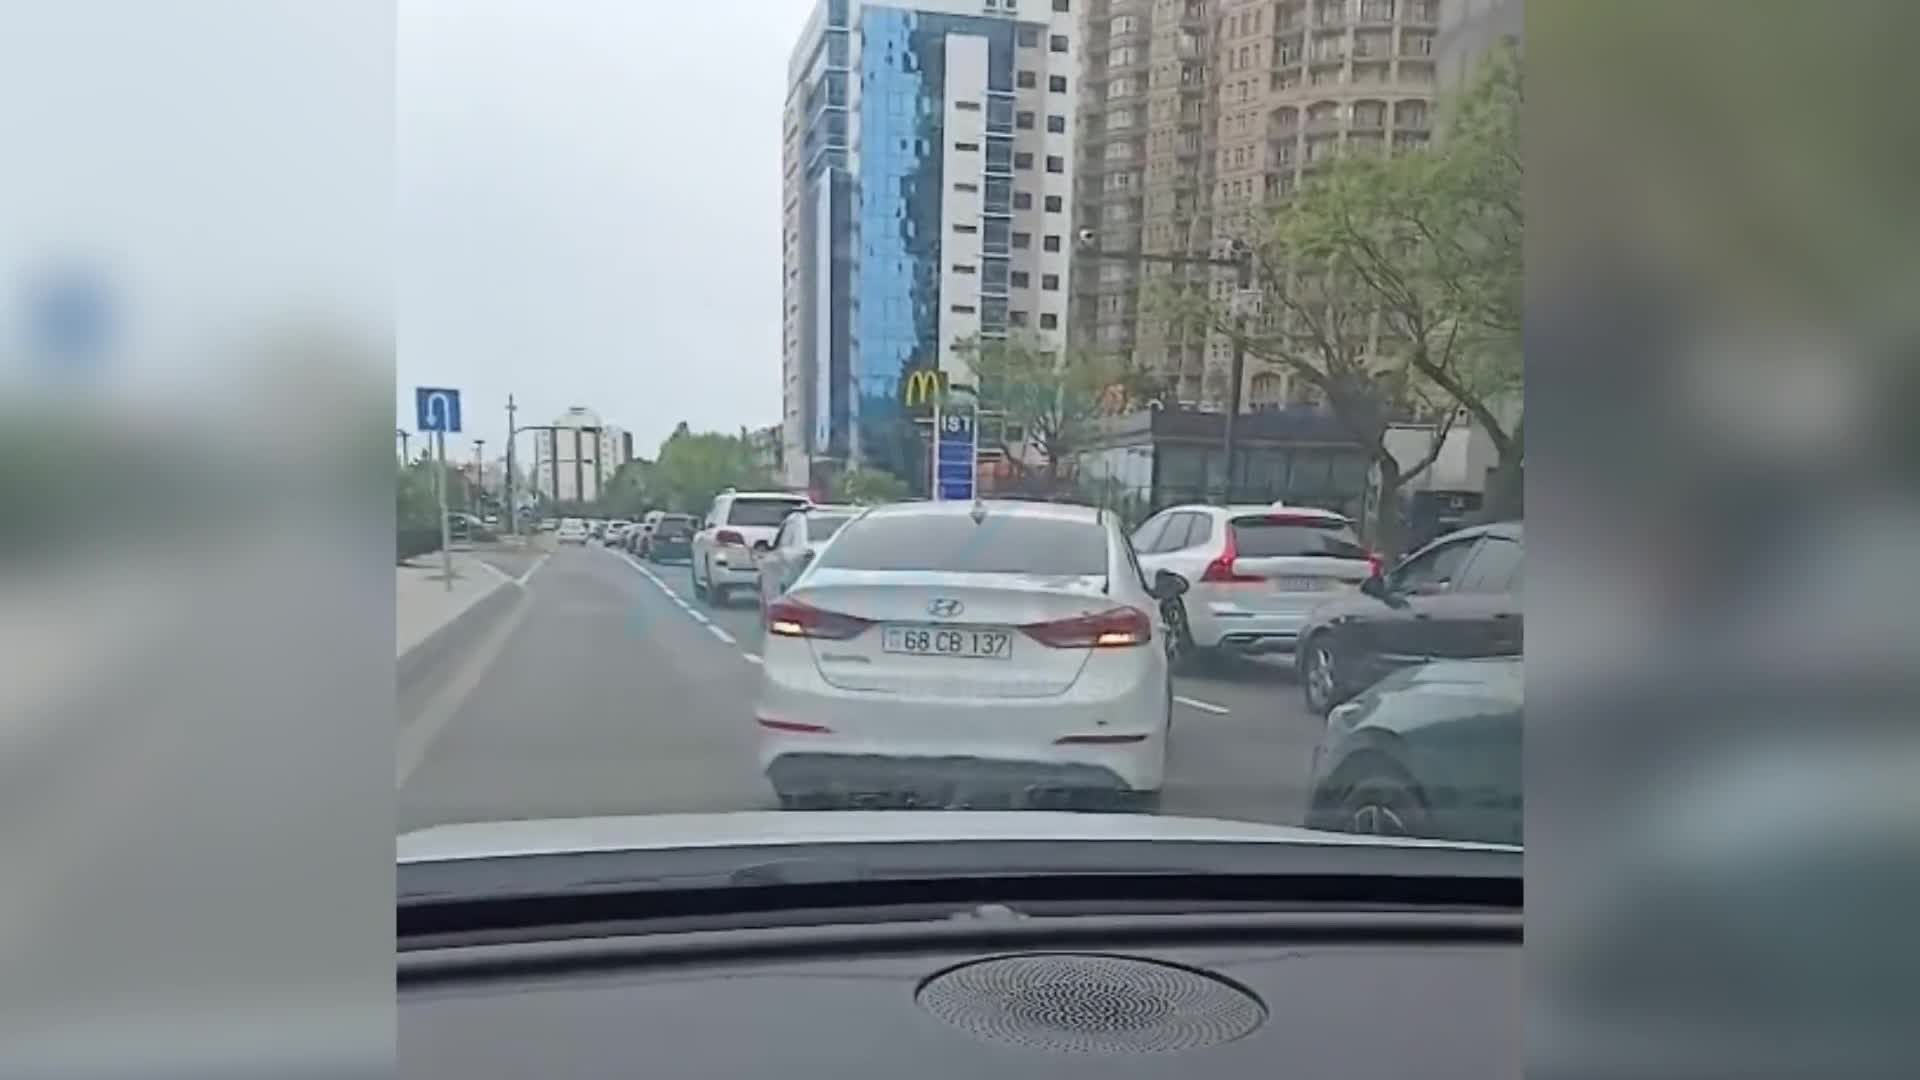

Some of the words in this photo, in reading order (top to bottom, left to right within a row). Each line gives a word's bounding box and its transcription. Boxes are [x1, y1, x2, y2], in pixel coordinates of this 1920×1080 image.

[904, 631, 930, 652] 68
[936, 632, 963, 653] CB
[973, 633, 1008, 655] 137
